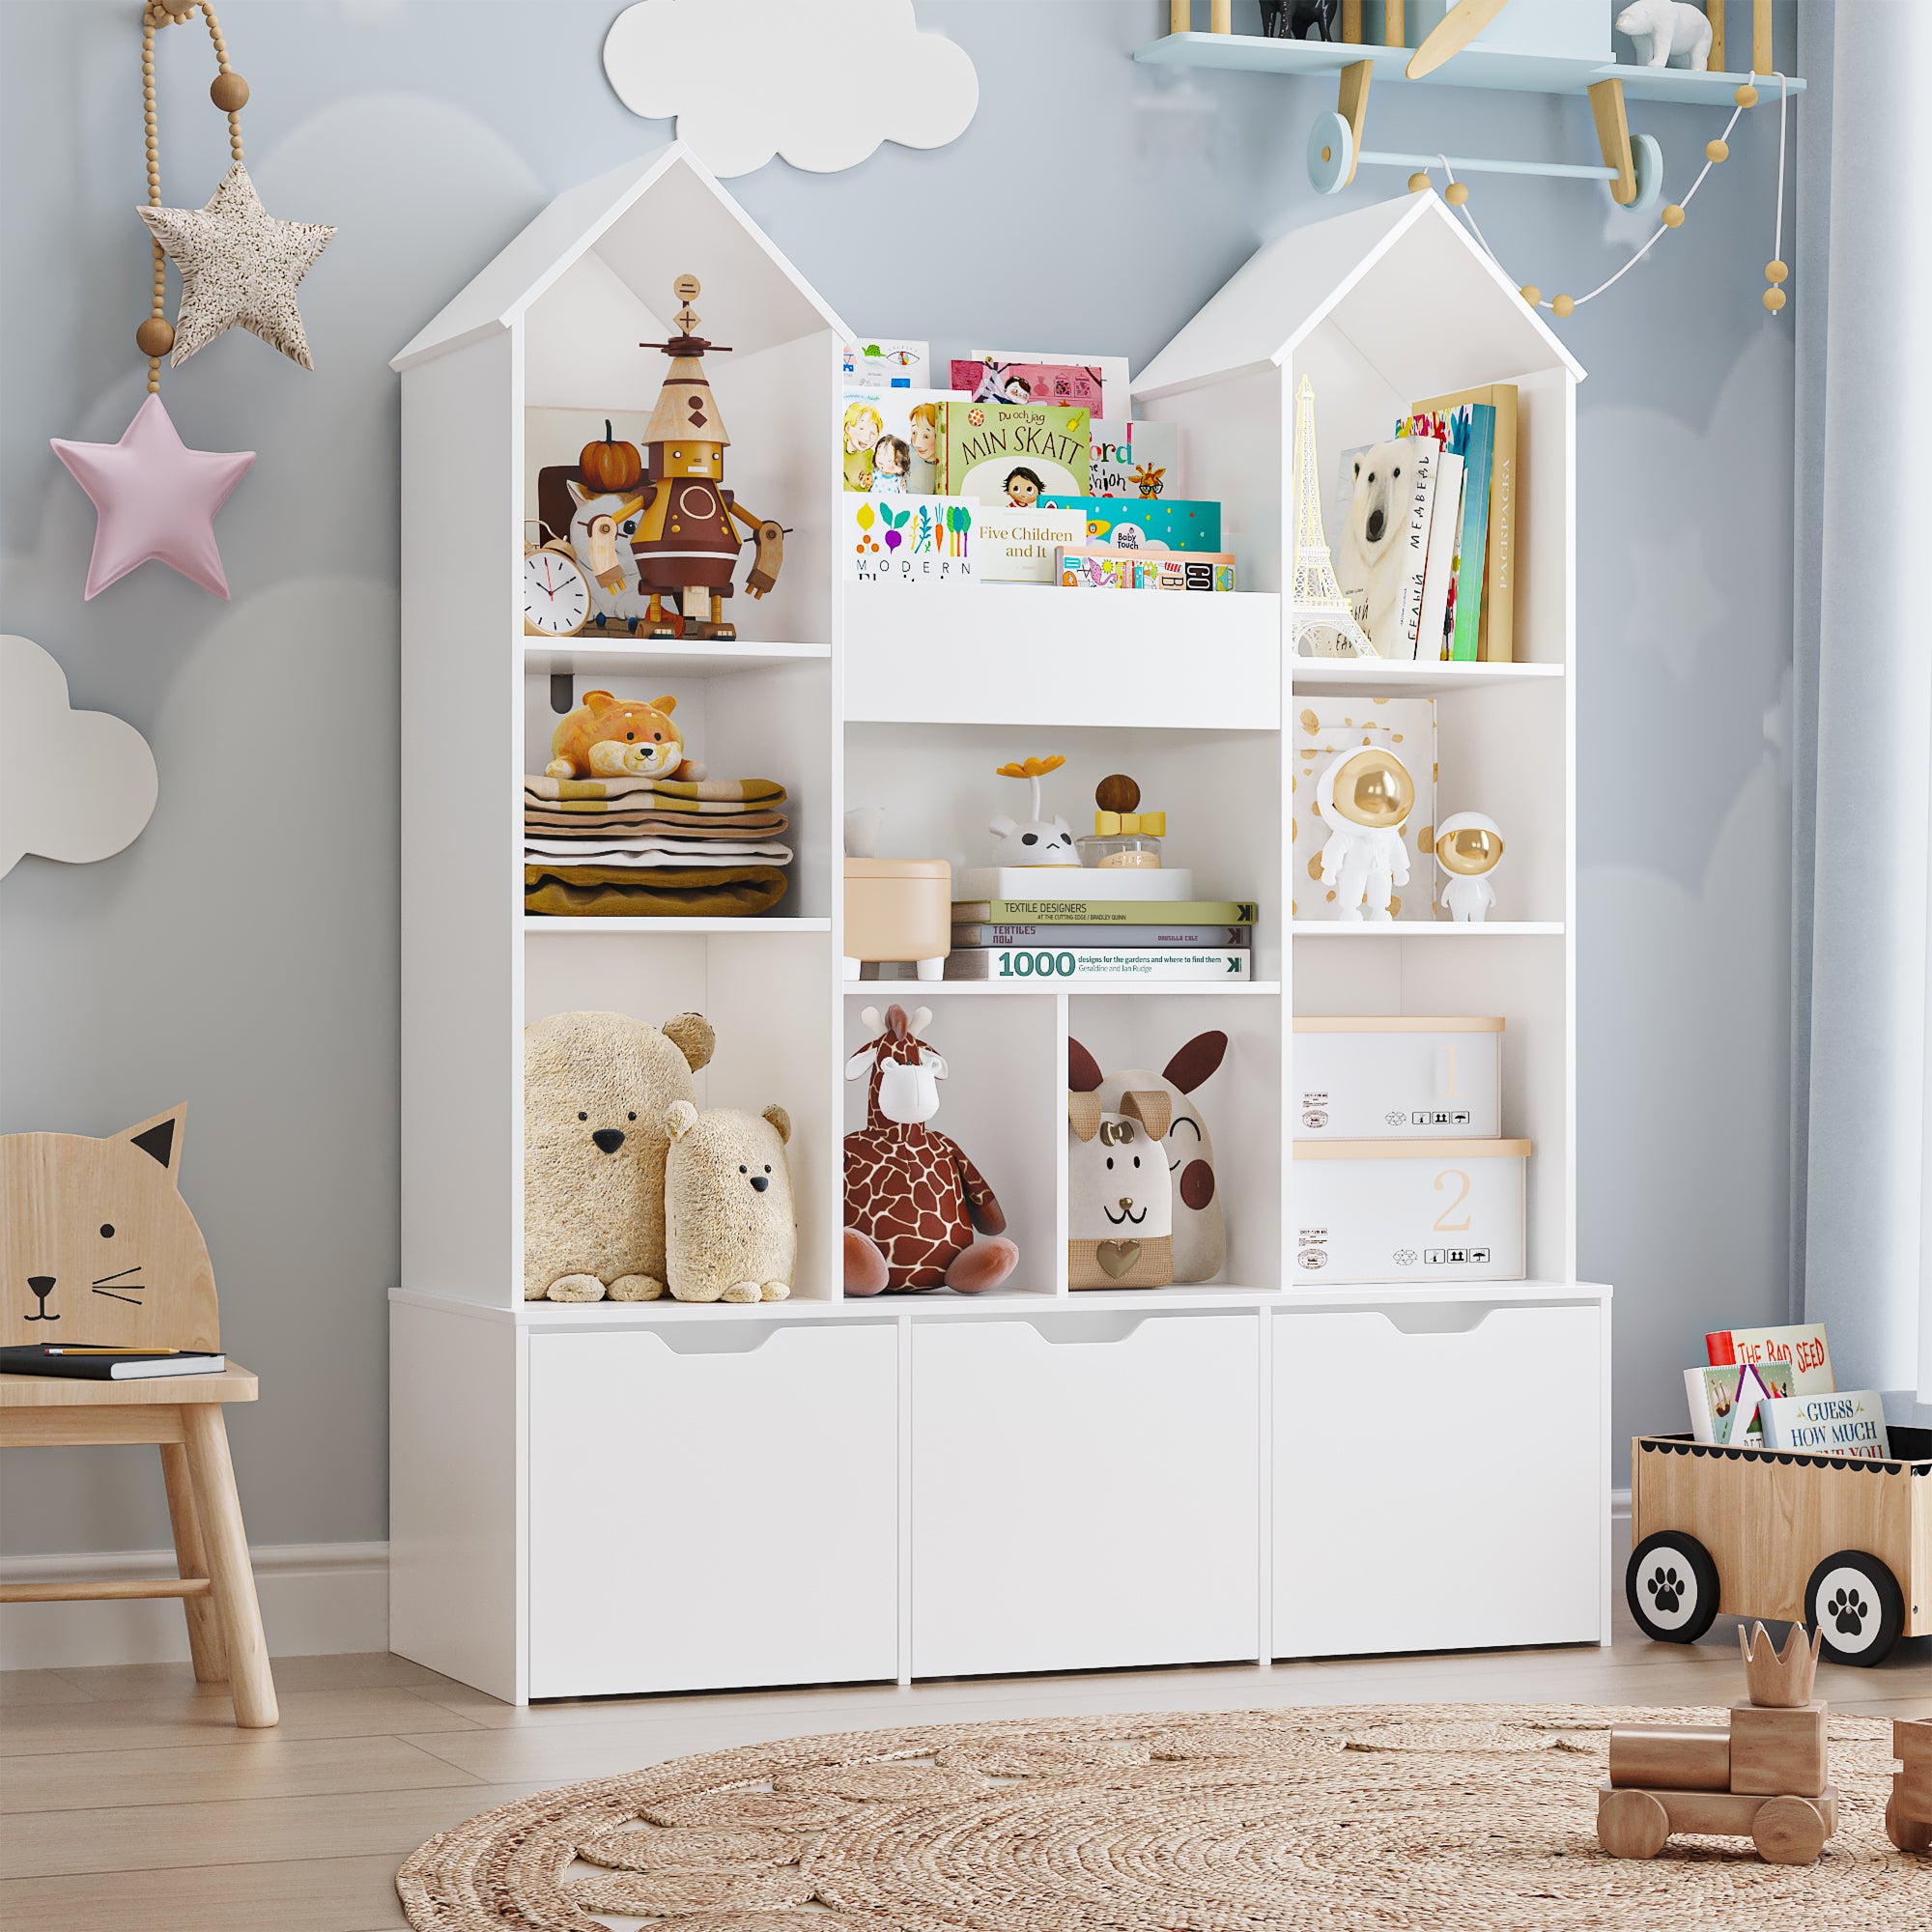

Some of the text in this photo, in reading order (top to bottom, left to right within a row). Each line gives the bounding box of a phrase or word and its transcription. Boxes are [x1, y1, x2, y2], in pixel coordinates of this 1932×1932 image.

[999, 411, 1045, 425] Du och jag
[961, 426, 1085, 465] MIN SKATT
[1090, 423, 1134, 465] ord
[1410, 457, 1429, 549] МЕДВЕДЬ
[980, 526, 1073, 542] Five Children
[1499, 460, 1510, 588] РАСКРАСКА
[1118, 532, 1137, 542] Baby
[1118, 541, 1139, 550] Touch
[1006, 545, 1047, 557] and It
[856, 559, 971, 575] MODERN
[1005, 903, 1087, 913] TEXTILE DESIGNERS
[993, 926, 1036, 935] TEXTILES
[999, 952, 1075, 977] 1000
[1078, 956, 1102, 965] designs
[1124, 956, 1151, 965] gardens
[1437, 1043, 1463, 1096] 1
[1433, 1169, 1471, 1232] 2
[1738, 1343, 1761, 1364] THE
[1797, 1337, 1825, 1373] SEED
[1806, 1400, 1854, 1421] GUESS
[1791, 1421, 1877, 1447] HOW MUCH
